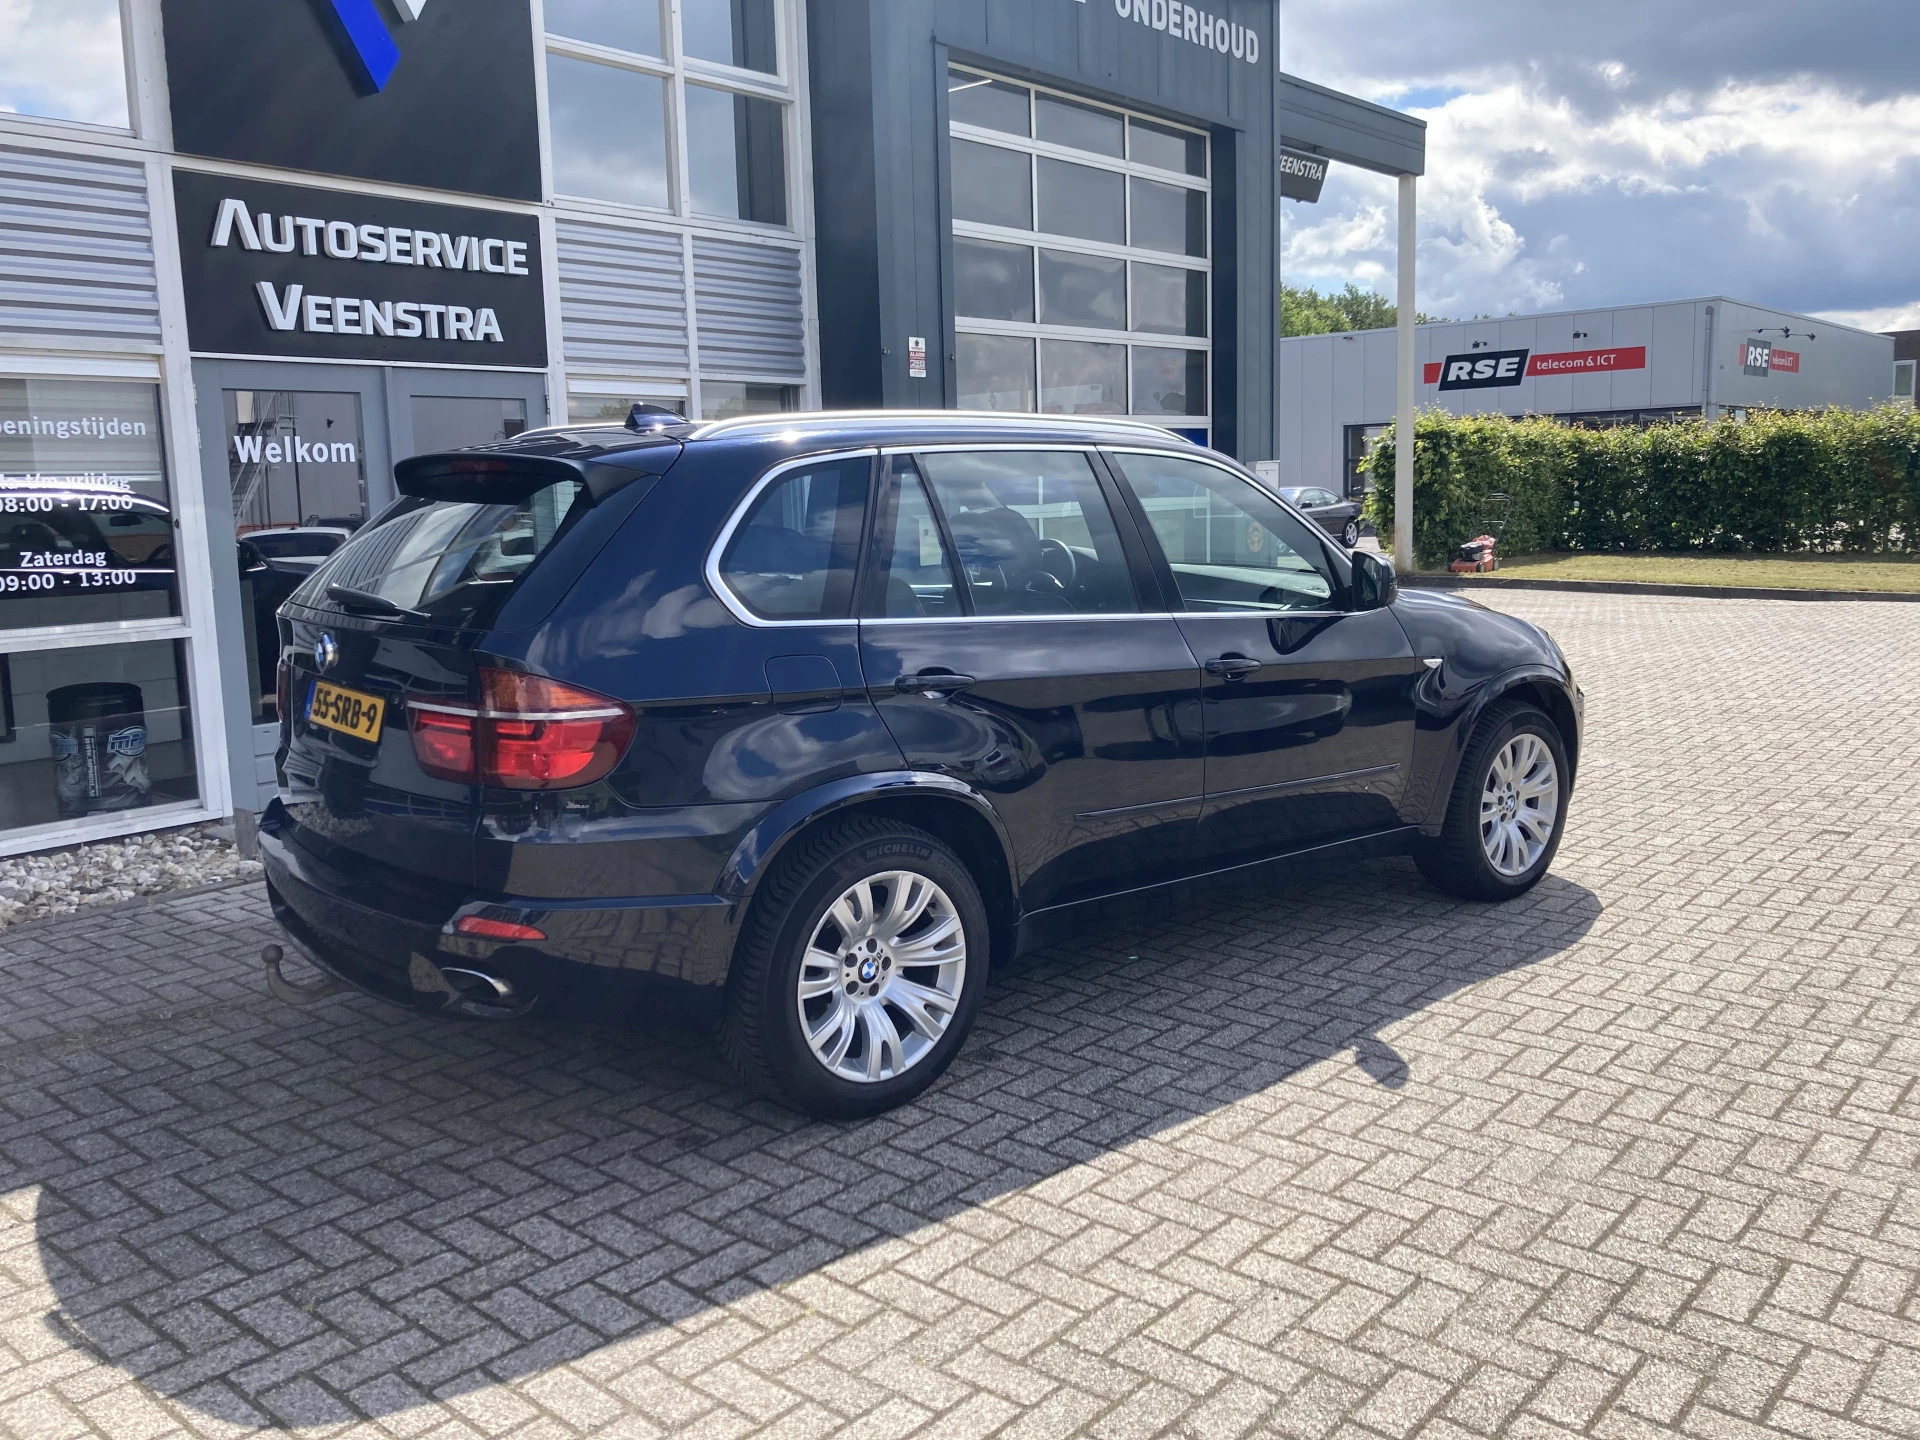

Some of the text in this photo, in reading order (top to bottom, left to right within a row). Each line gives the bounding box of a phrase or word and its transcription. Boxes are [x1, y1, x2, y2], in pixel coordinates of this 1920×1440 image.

[1114, 0, 1259, 64] ONDERHOUD
[1280, 155, 1323, 181] EENSTRA
[210, 198, 529, 275] AUTOSERVICE
[255, 281, 504, 342] VEENSTRA
[1447, 354, 1616, 381] RSE telecom & ICT
[1747, 346, 1769, 368] RSE
[0, 416, 146, 439] eningstijden
[234, 435, 356, 463] Welkom
[0, 497, 53, 513] 8:00
[79, 495, 133, 512] 17:00
[20, 550, 107, 567] Zaterdag
[79, 569, 136, 588] 13:00
[313, 687, 378, 734] 55-SRB-9
[866, 843, 931, 859] MICHELIN
